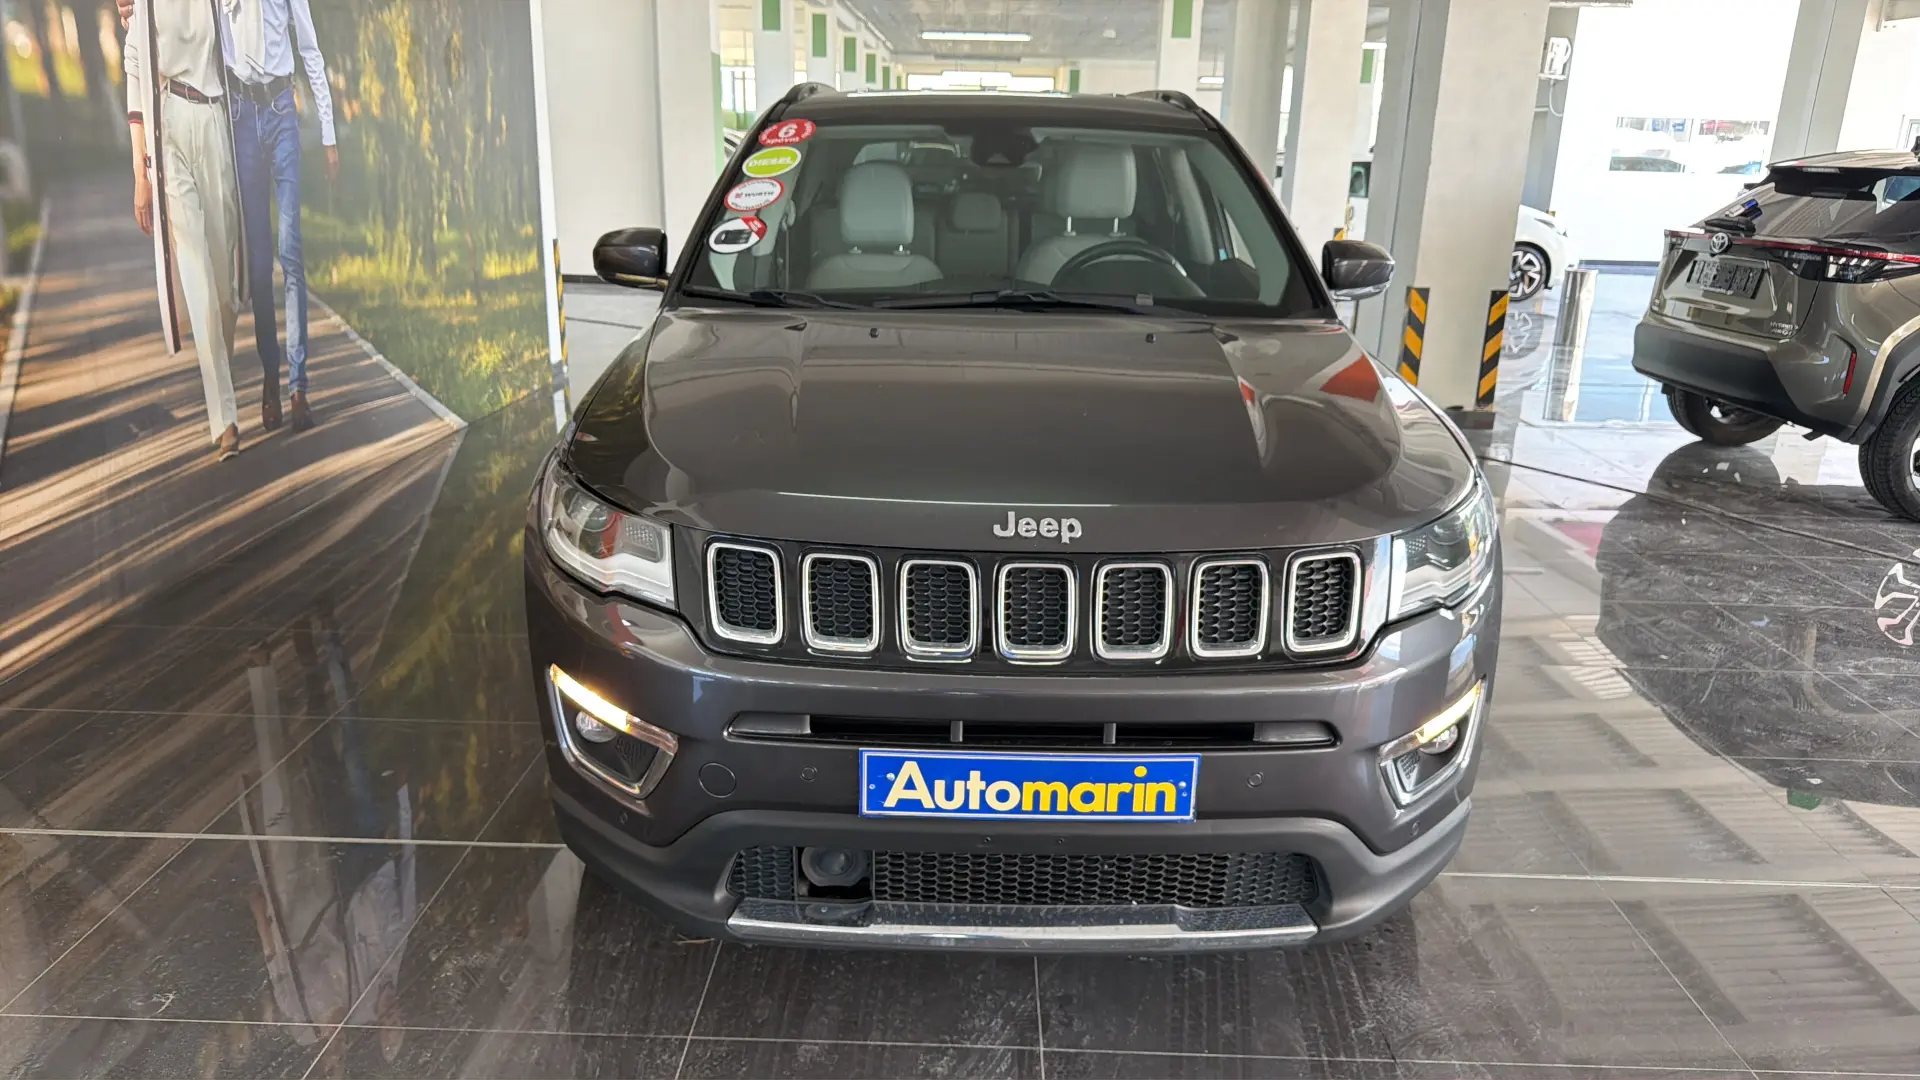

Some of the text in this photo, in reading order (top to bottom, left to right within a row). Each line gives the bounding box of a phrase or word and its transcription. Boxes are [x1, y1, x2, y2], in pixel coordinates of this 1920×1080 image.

[778, 123, 798, 138] 6
[748, 156, 793, 167] DIESEL
[992, 511, 1082, 543] Jeep
[883, 761, 1177, 813] Automarin
